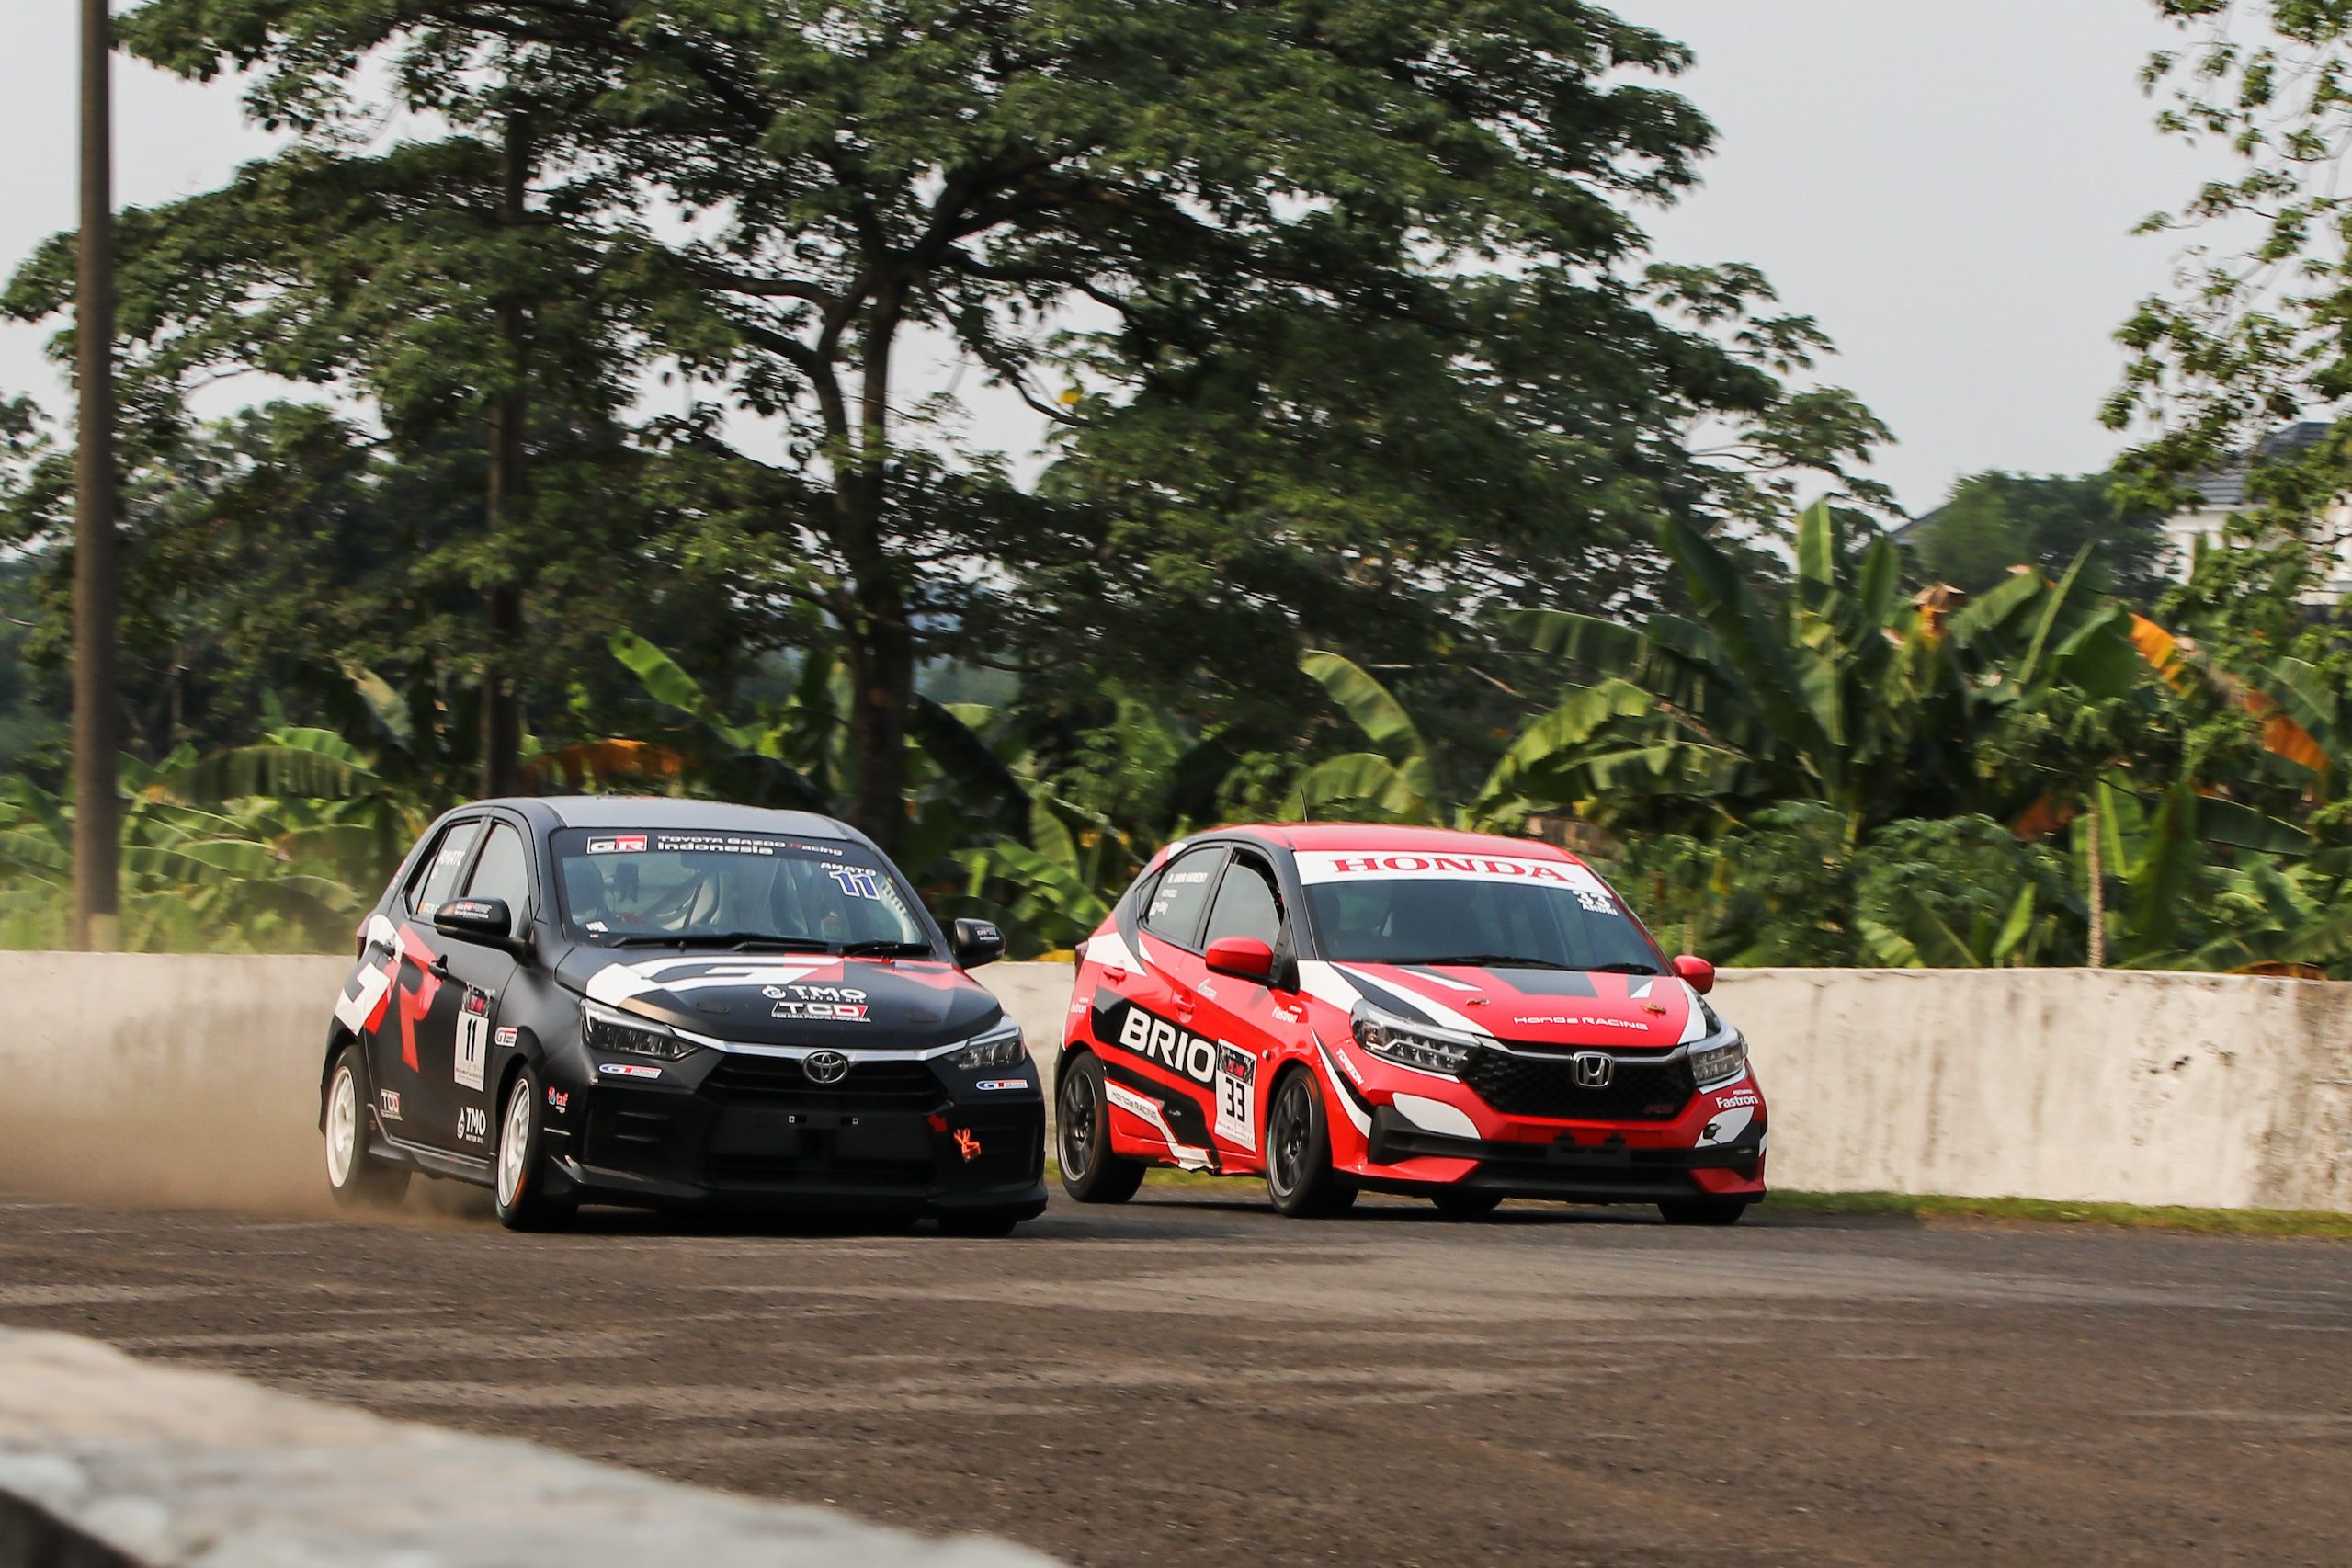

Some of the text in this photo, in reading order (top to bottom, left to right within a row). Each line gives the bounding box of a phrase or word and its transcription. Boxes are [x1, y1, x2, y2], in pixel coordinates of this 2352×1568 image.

[590, 835, 645, 852] GR
[658, 835, 723, 845] TOYOTA
[727, 836, 786, 848] GAZOO
[658, 841, 773, 855] Indonesia
[821, 861, 876, 876] AMATO
[1328, 857, 1577, 883] HONDA
[829, 871, 881, 900] 11
[1573, 890, 1612, 908] 33
[788, 984, 868, 1000] TMO
[778, 1002, 860, 1017] TCD
[1514, 1017, 1648, 1031] Honda RACING
[465, 1018, 477, 1062] 11
[1119, 1006, 1216, 1083] BRIO
[1225, 1076, 1245, 1122] 33
[1715, 1096, 1758, 1108] Fastron
[466, 1107, 487, 1136] TMO
